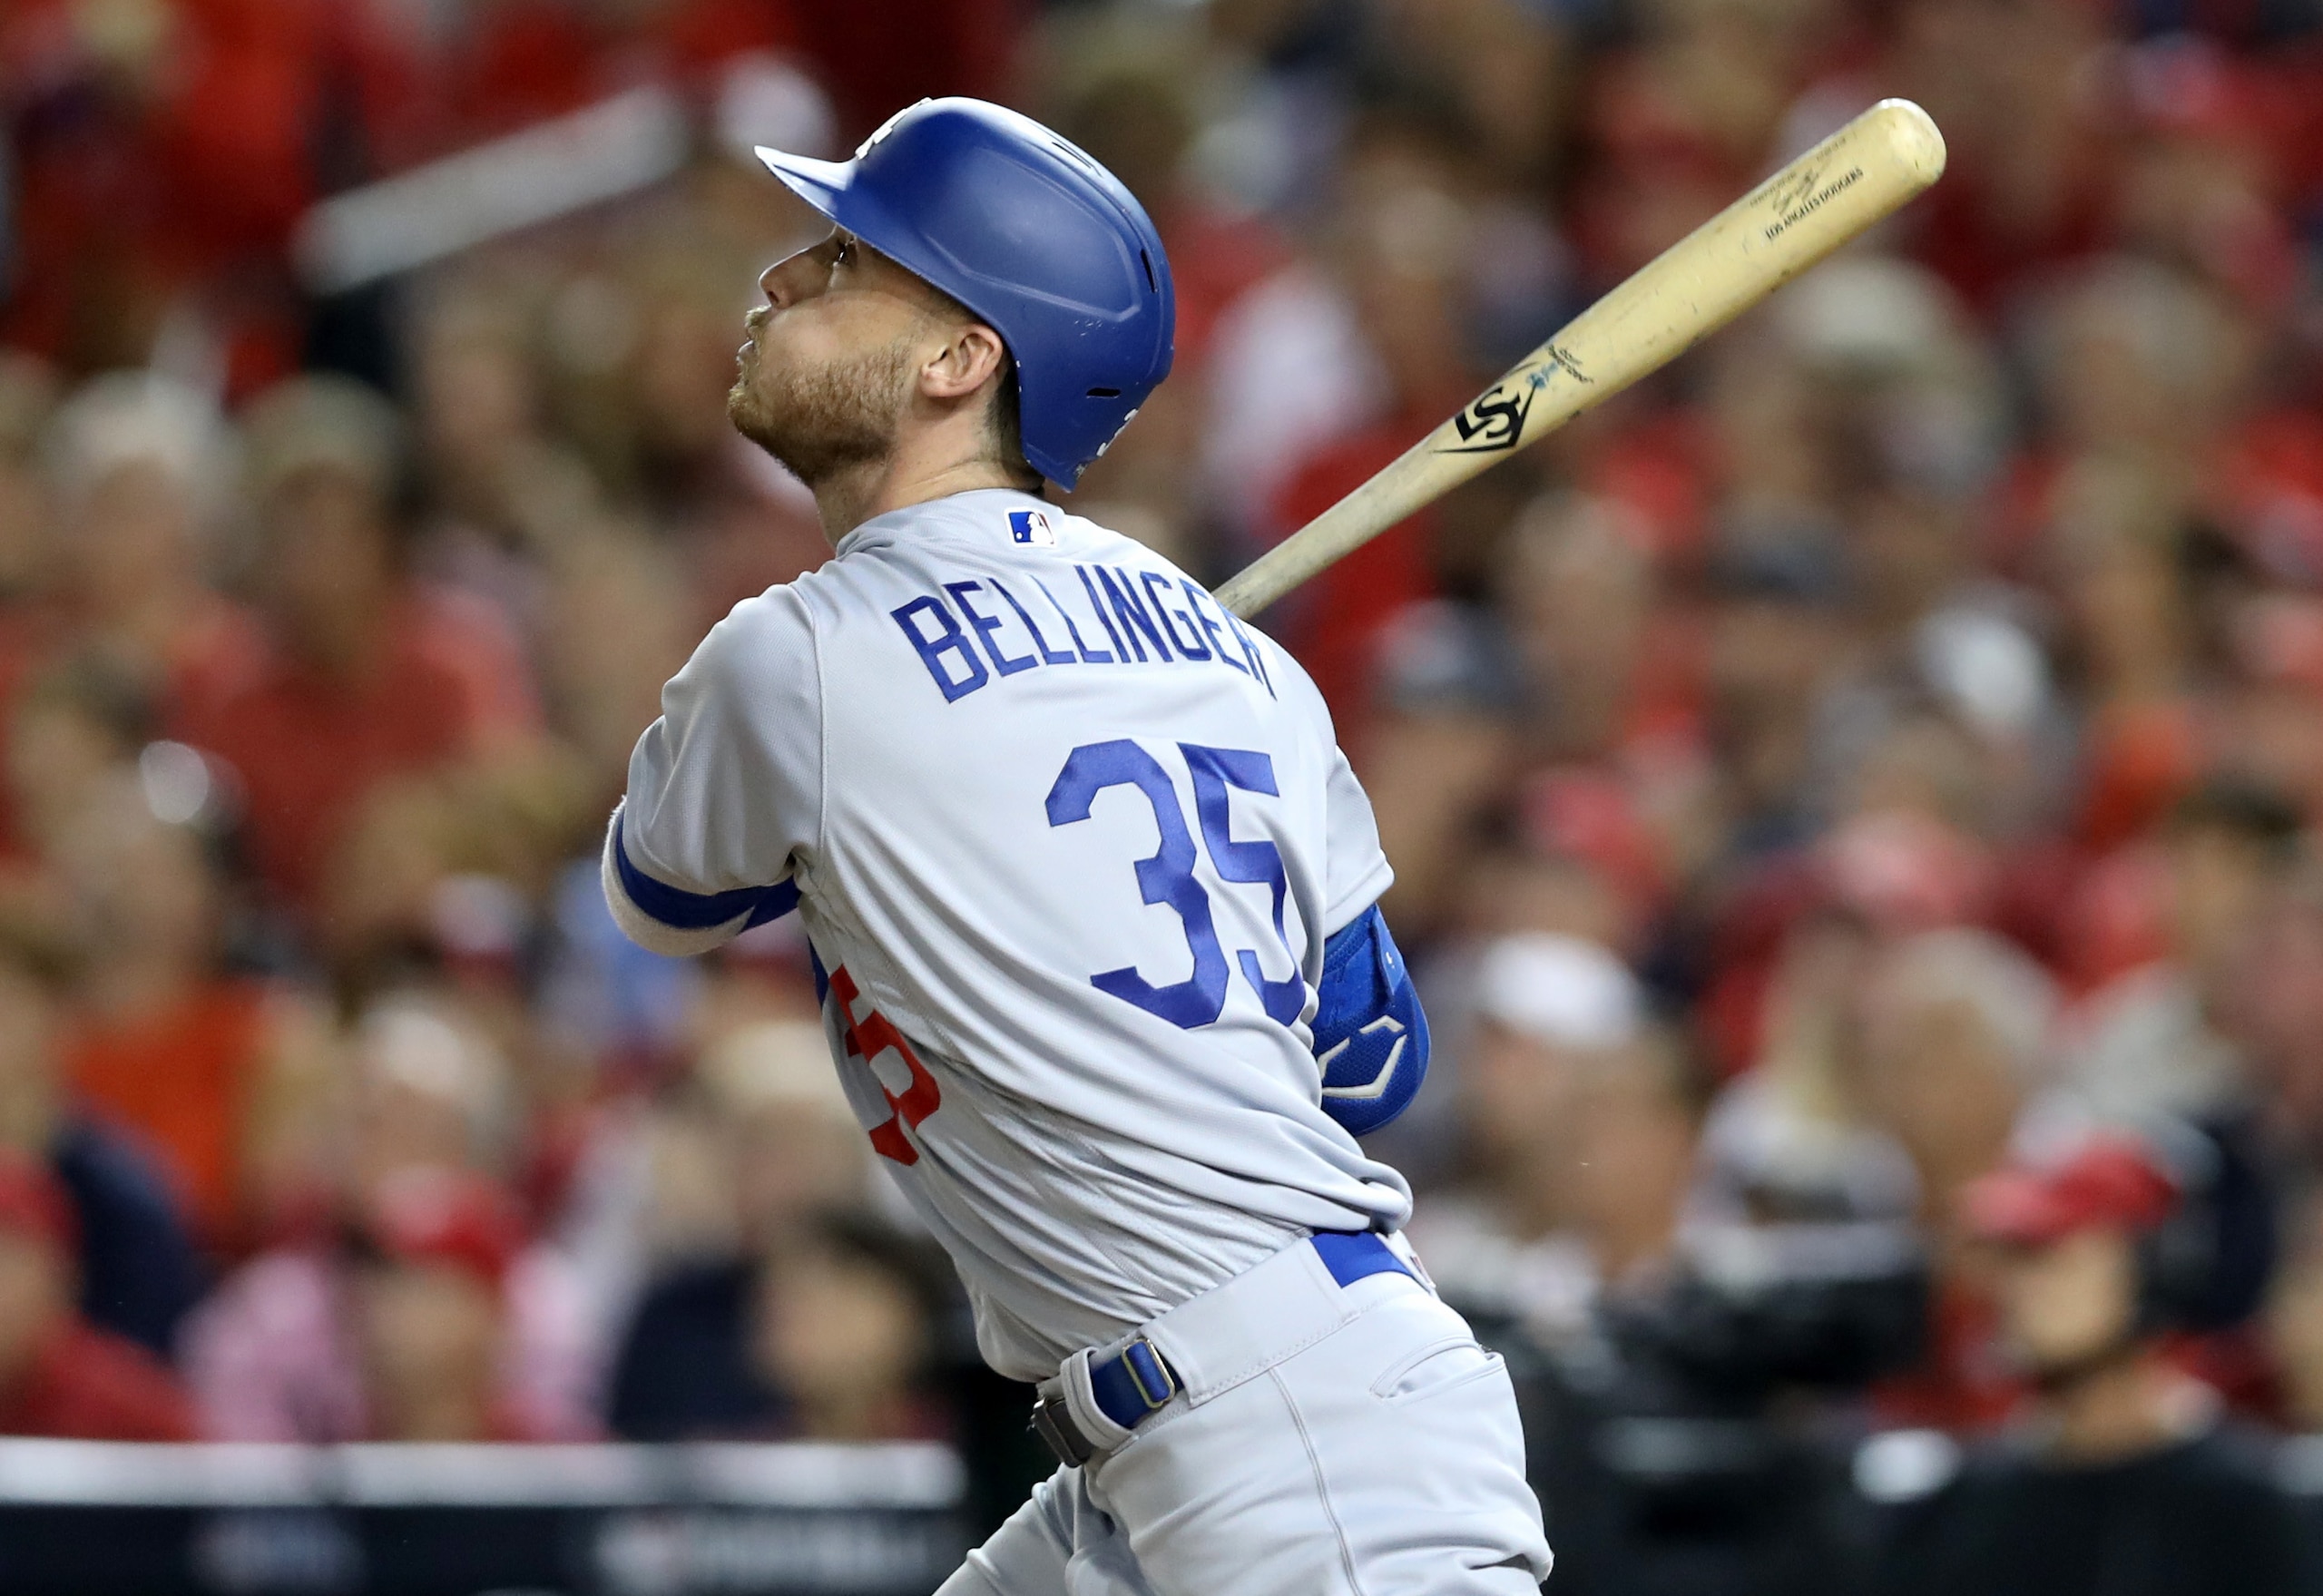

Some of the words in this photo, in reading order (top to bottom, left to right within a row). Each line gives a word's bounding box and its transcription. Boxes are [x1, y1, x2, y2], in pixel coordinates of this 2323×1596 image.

[1765, 221, 1784, 240] LOS
[1782, 195, 1820, 228] ANGELES
[1818, 165, 1863, 202] DODGERS
[889, 563, 1278, 704] BELLINGER
[1044, 738, 1308, 1031] 35
